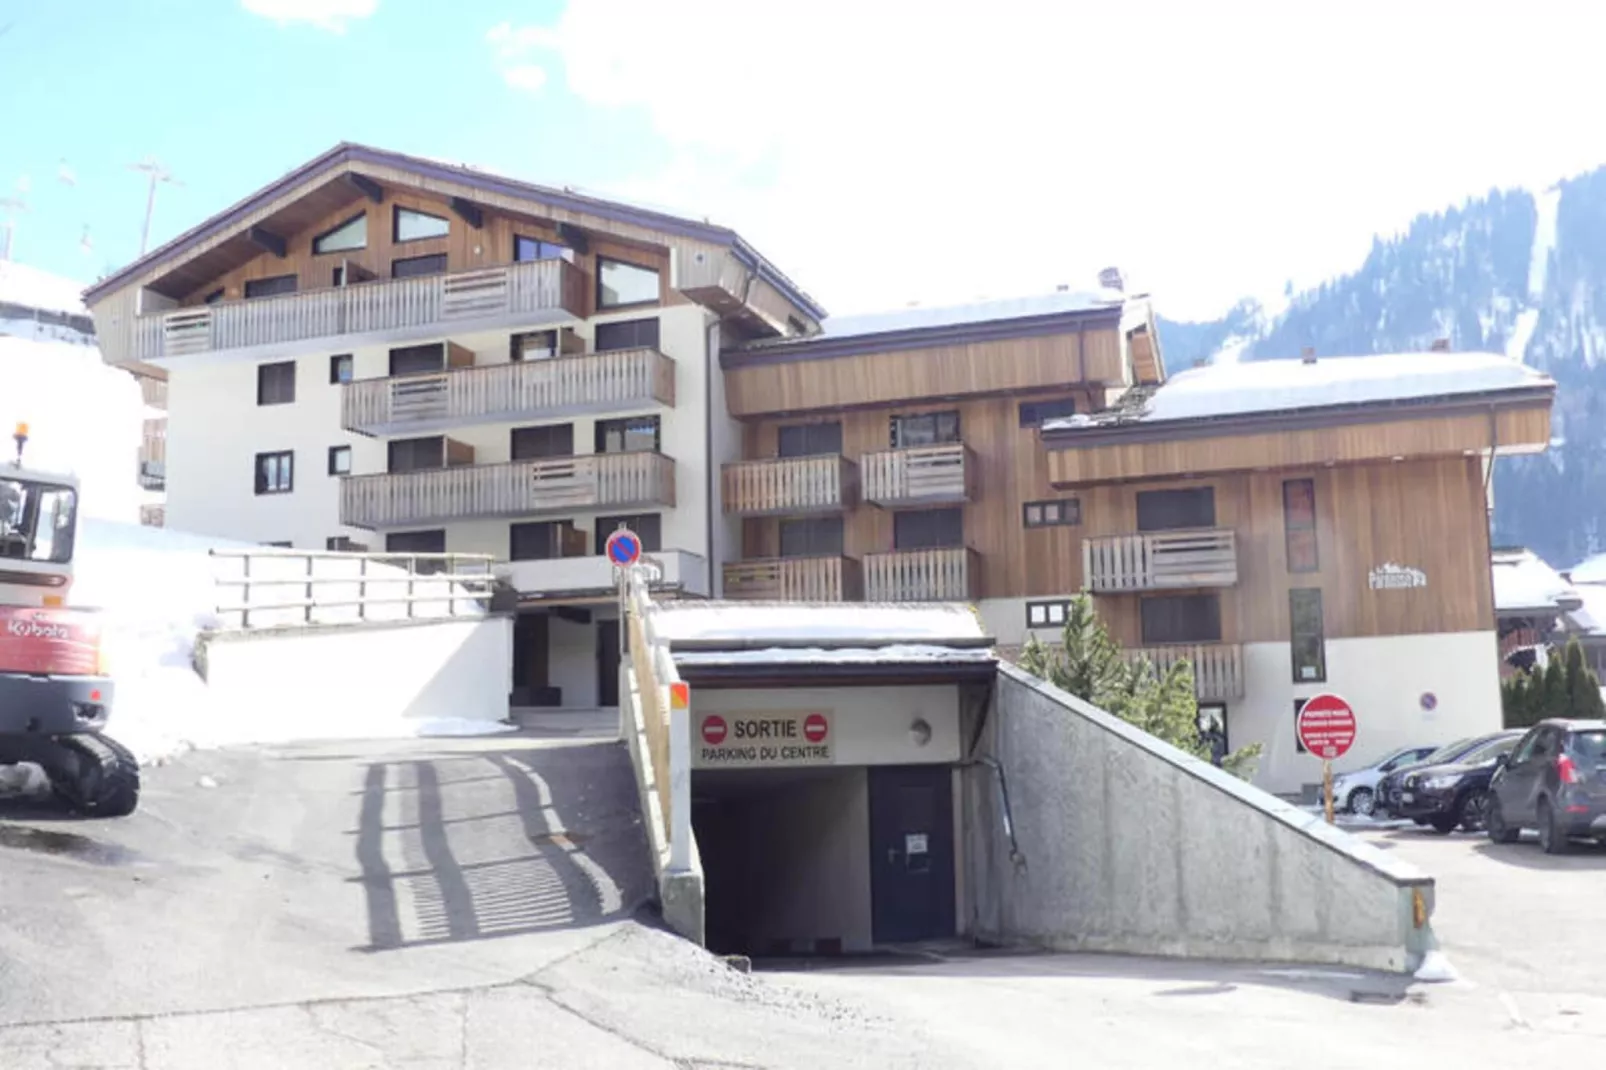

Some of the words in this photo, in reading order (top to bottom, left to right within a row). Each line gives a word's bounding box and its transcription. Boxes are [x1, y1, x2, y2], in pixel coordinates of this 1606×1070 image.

[7, 620, 69, 639] Kubota
[734, 719, 797, 738] SORTIE
[702, 746, 756, 761] PARKING
[760, 746, 777, 760] DU
[781, 745, 830, 759] CENTRE
